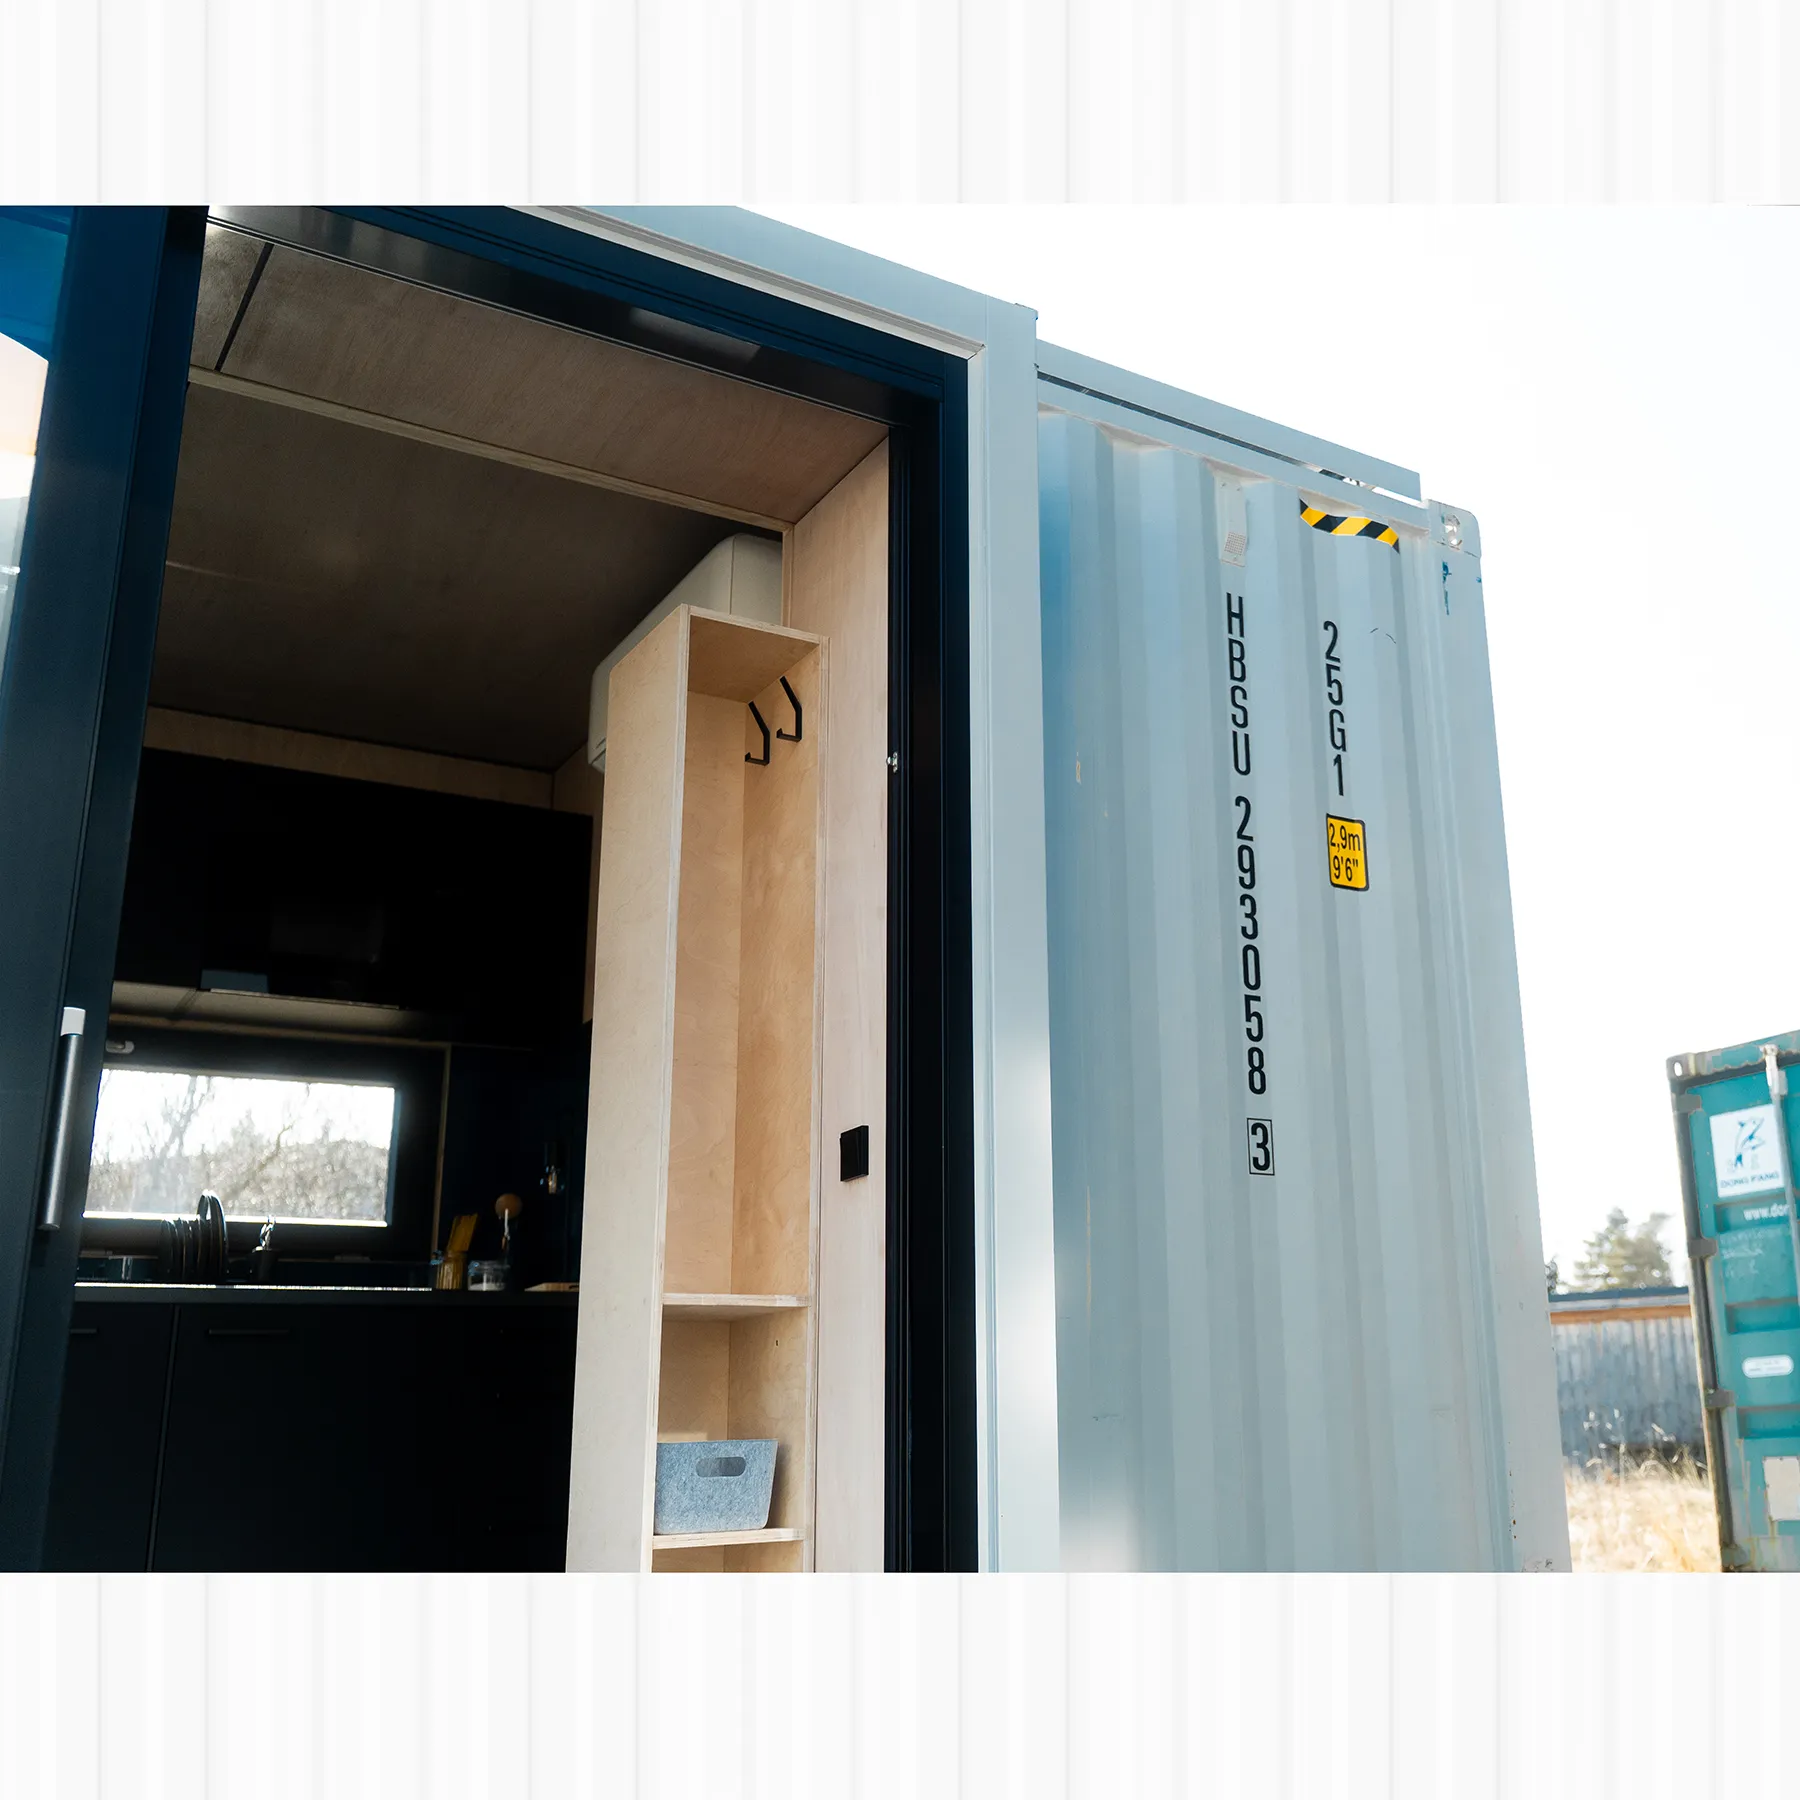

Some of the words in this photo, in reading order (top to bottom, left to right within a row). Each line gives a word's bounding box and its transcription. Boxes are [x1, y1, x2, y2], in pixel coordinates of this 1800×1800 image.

[1226, 592, 1251, 776] HBSU
[1323, 620, 1347, 797] 25G1
[1329, 822, 1361, 852] 2,9m
[1333, 855, 1359, 882] 9'6"
[1234, 795, 1267, 1095] 293058
[1250, 1122, 1271, 1171] 3
